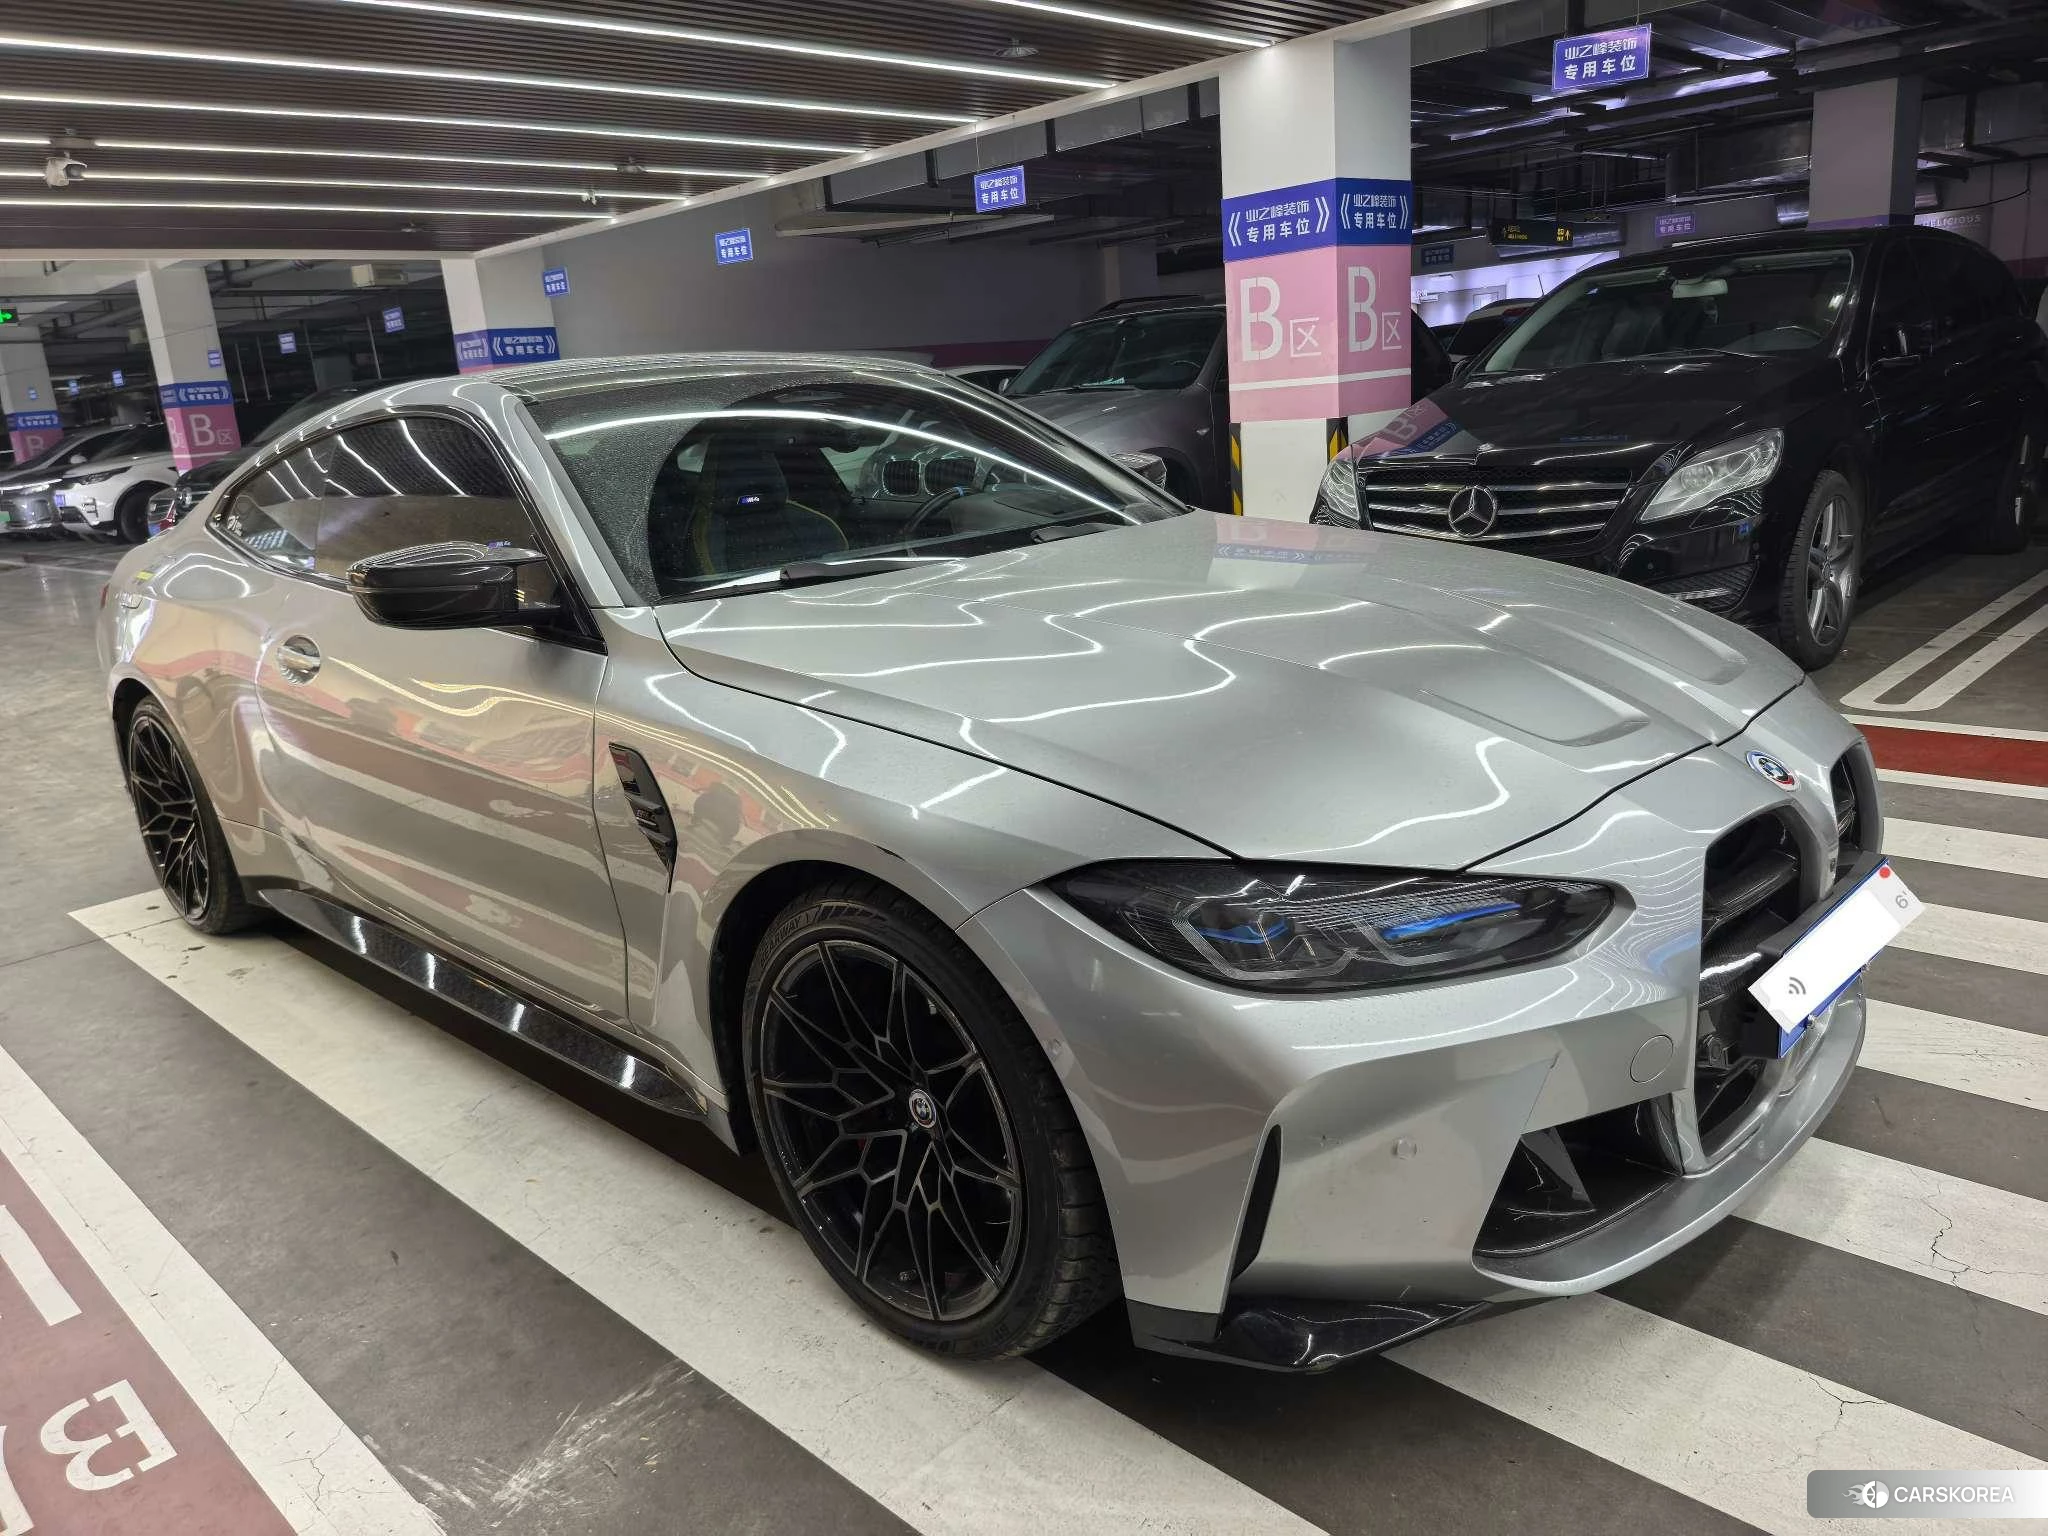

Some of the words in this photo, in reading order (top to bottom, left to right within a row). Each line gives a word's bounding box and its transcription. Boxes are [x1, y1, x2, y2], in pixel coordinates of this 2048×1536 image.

[1564, 38, 1637, 60] 业之峰装饰
[1564, 55, 1636, 80] 专用车位
[1245, 200, 1310, 223] 业之峰装饰
[1353, 194, 1397, 208] 业之峰装饰
[1246, 218, 1311, 243] 专用车位
[1354, 212, 1397, 229] 专用车位
